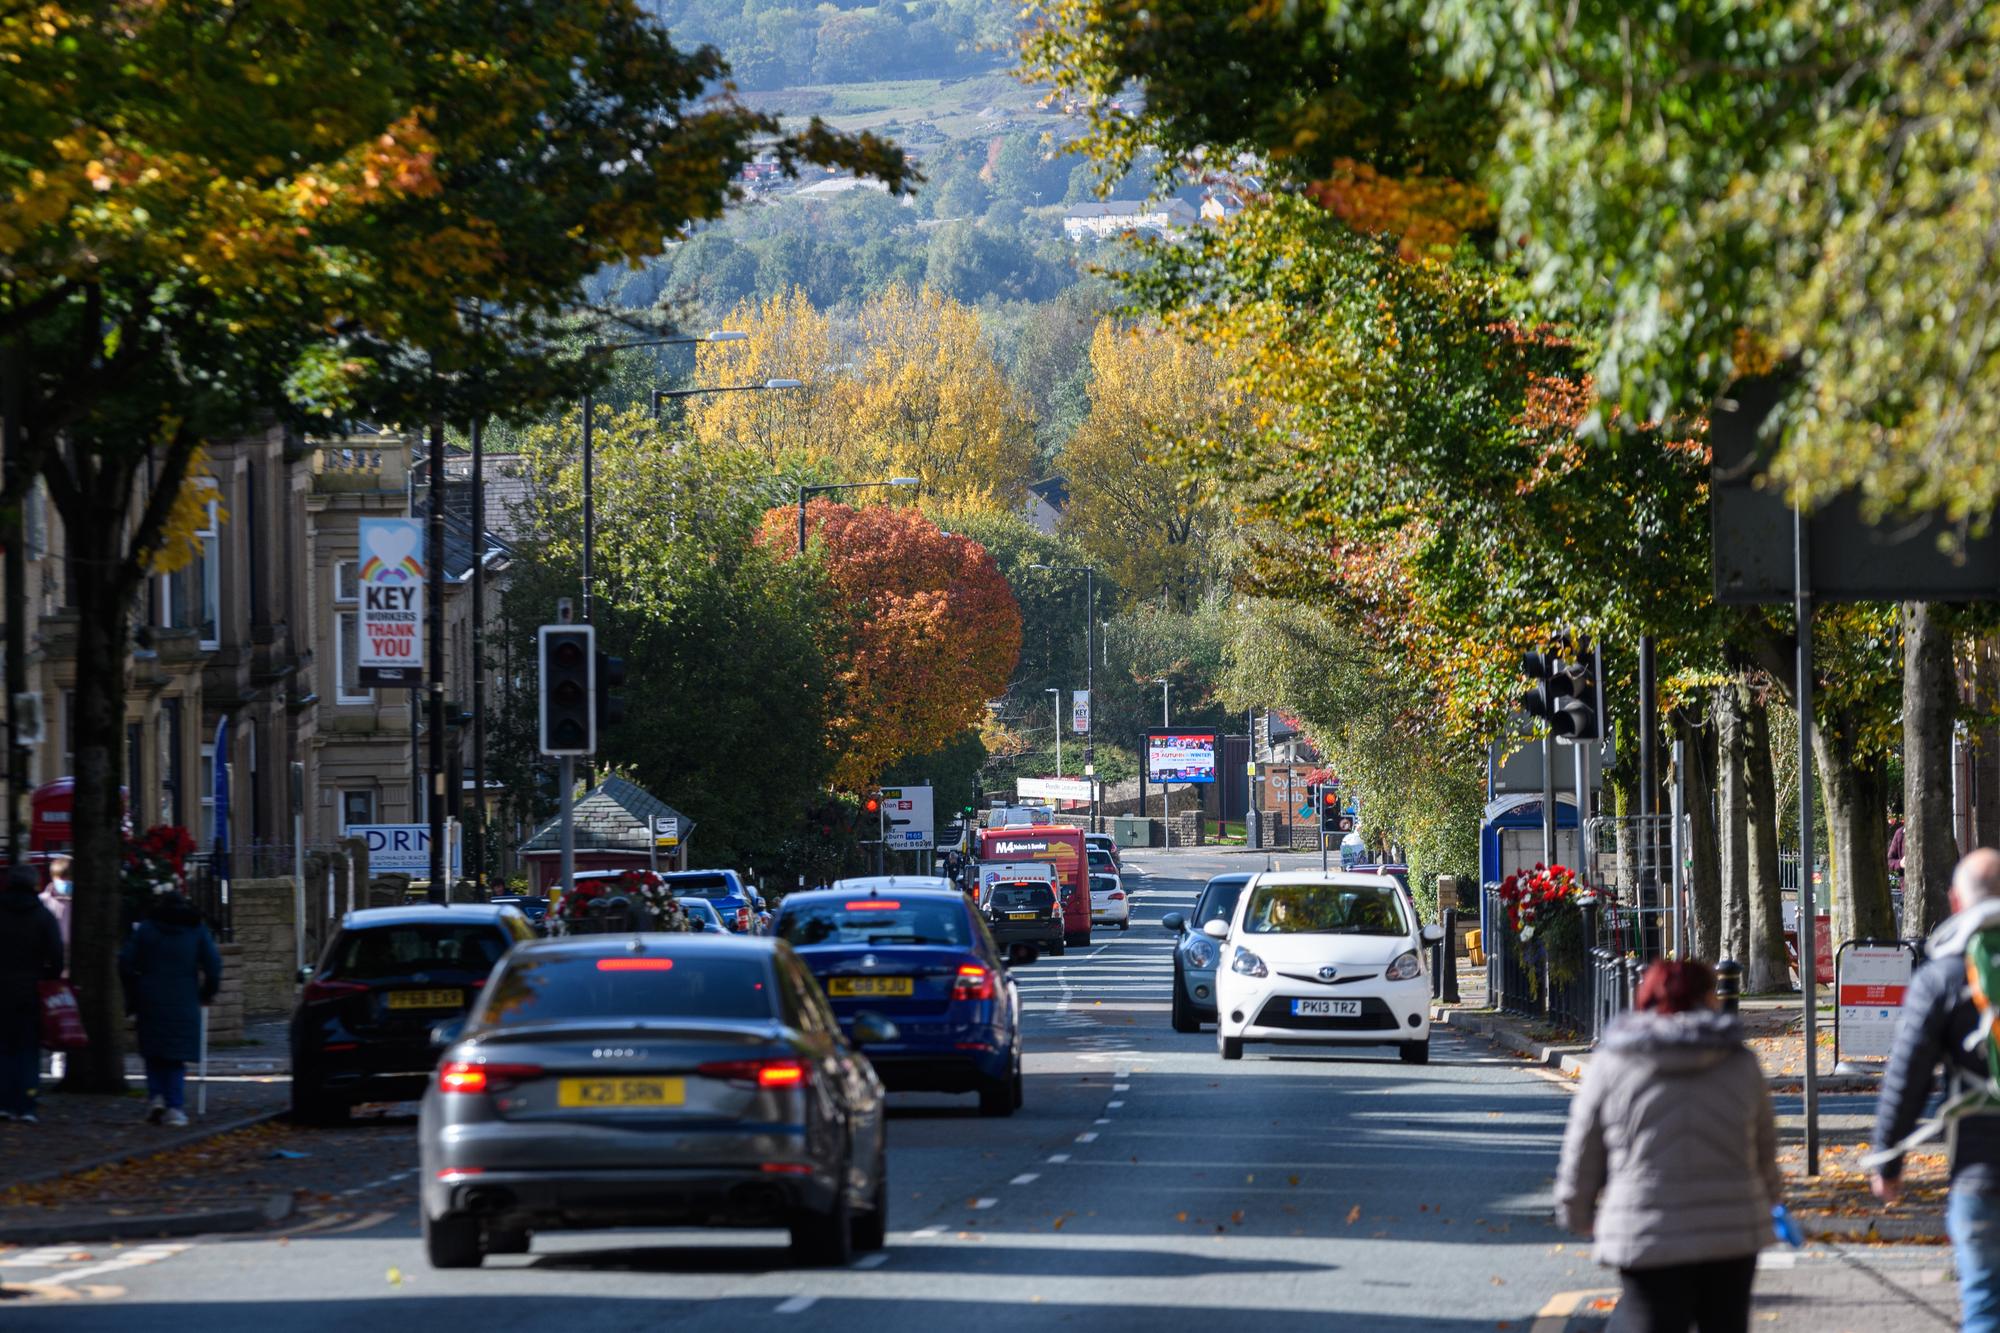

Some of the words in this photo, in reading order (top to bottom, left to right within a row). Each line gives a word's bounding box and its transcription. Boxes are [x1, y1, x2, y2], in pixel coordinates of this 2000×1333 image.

[366, 586, 416, 610] KEY
[366, 611, 417, 622] WORKERS
[366, 623, 416, 637] THANK
[371, 638, 412, 657] YOU
[1271, 775, 1308, 790] Cycle
[1276, 791, 1304, 802] Hub
[995, 841, 1014, 854] M4
[1302, 1001, 1330, 1013] PK13
[1333, 1001, 1357, 1014] TRZ
[580, 1081, 616, 1102] K21
[619, 1081, 664, 1102] SRN
